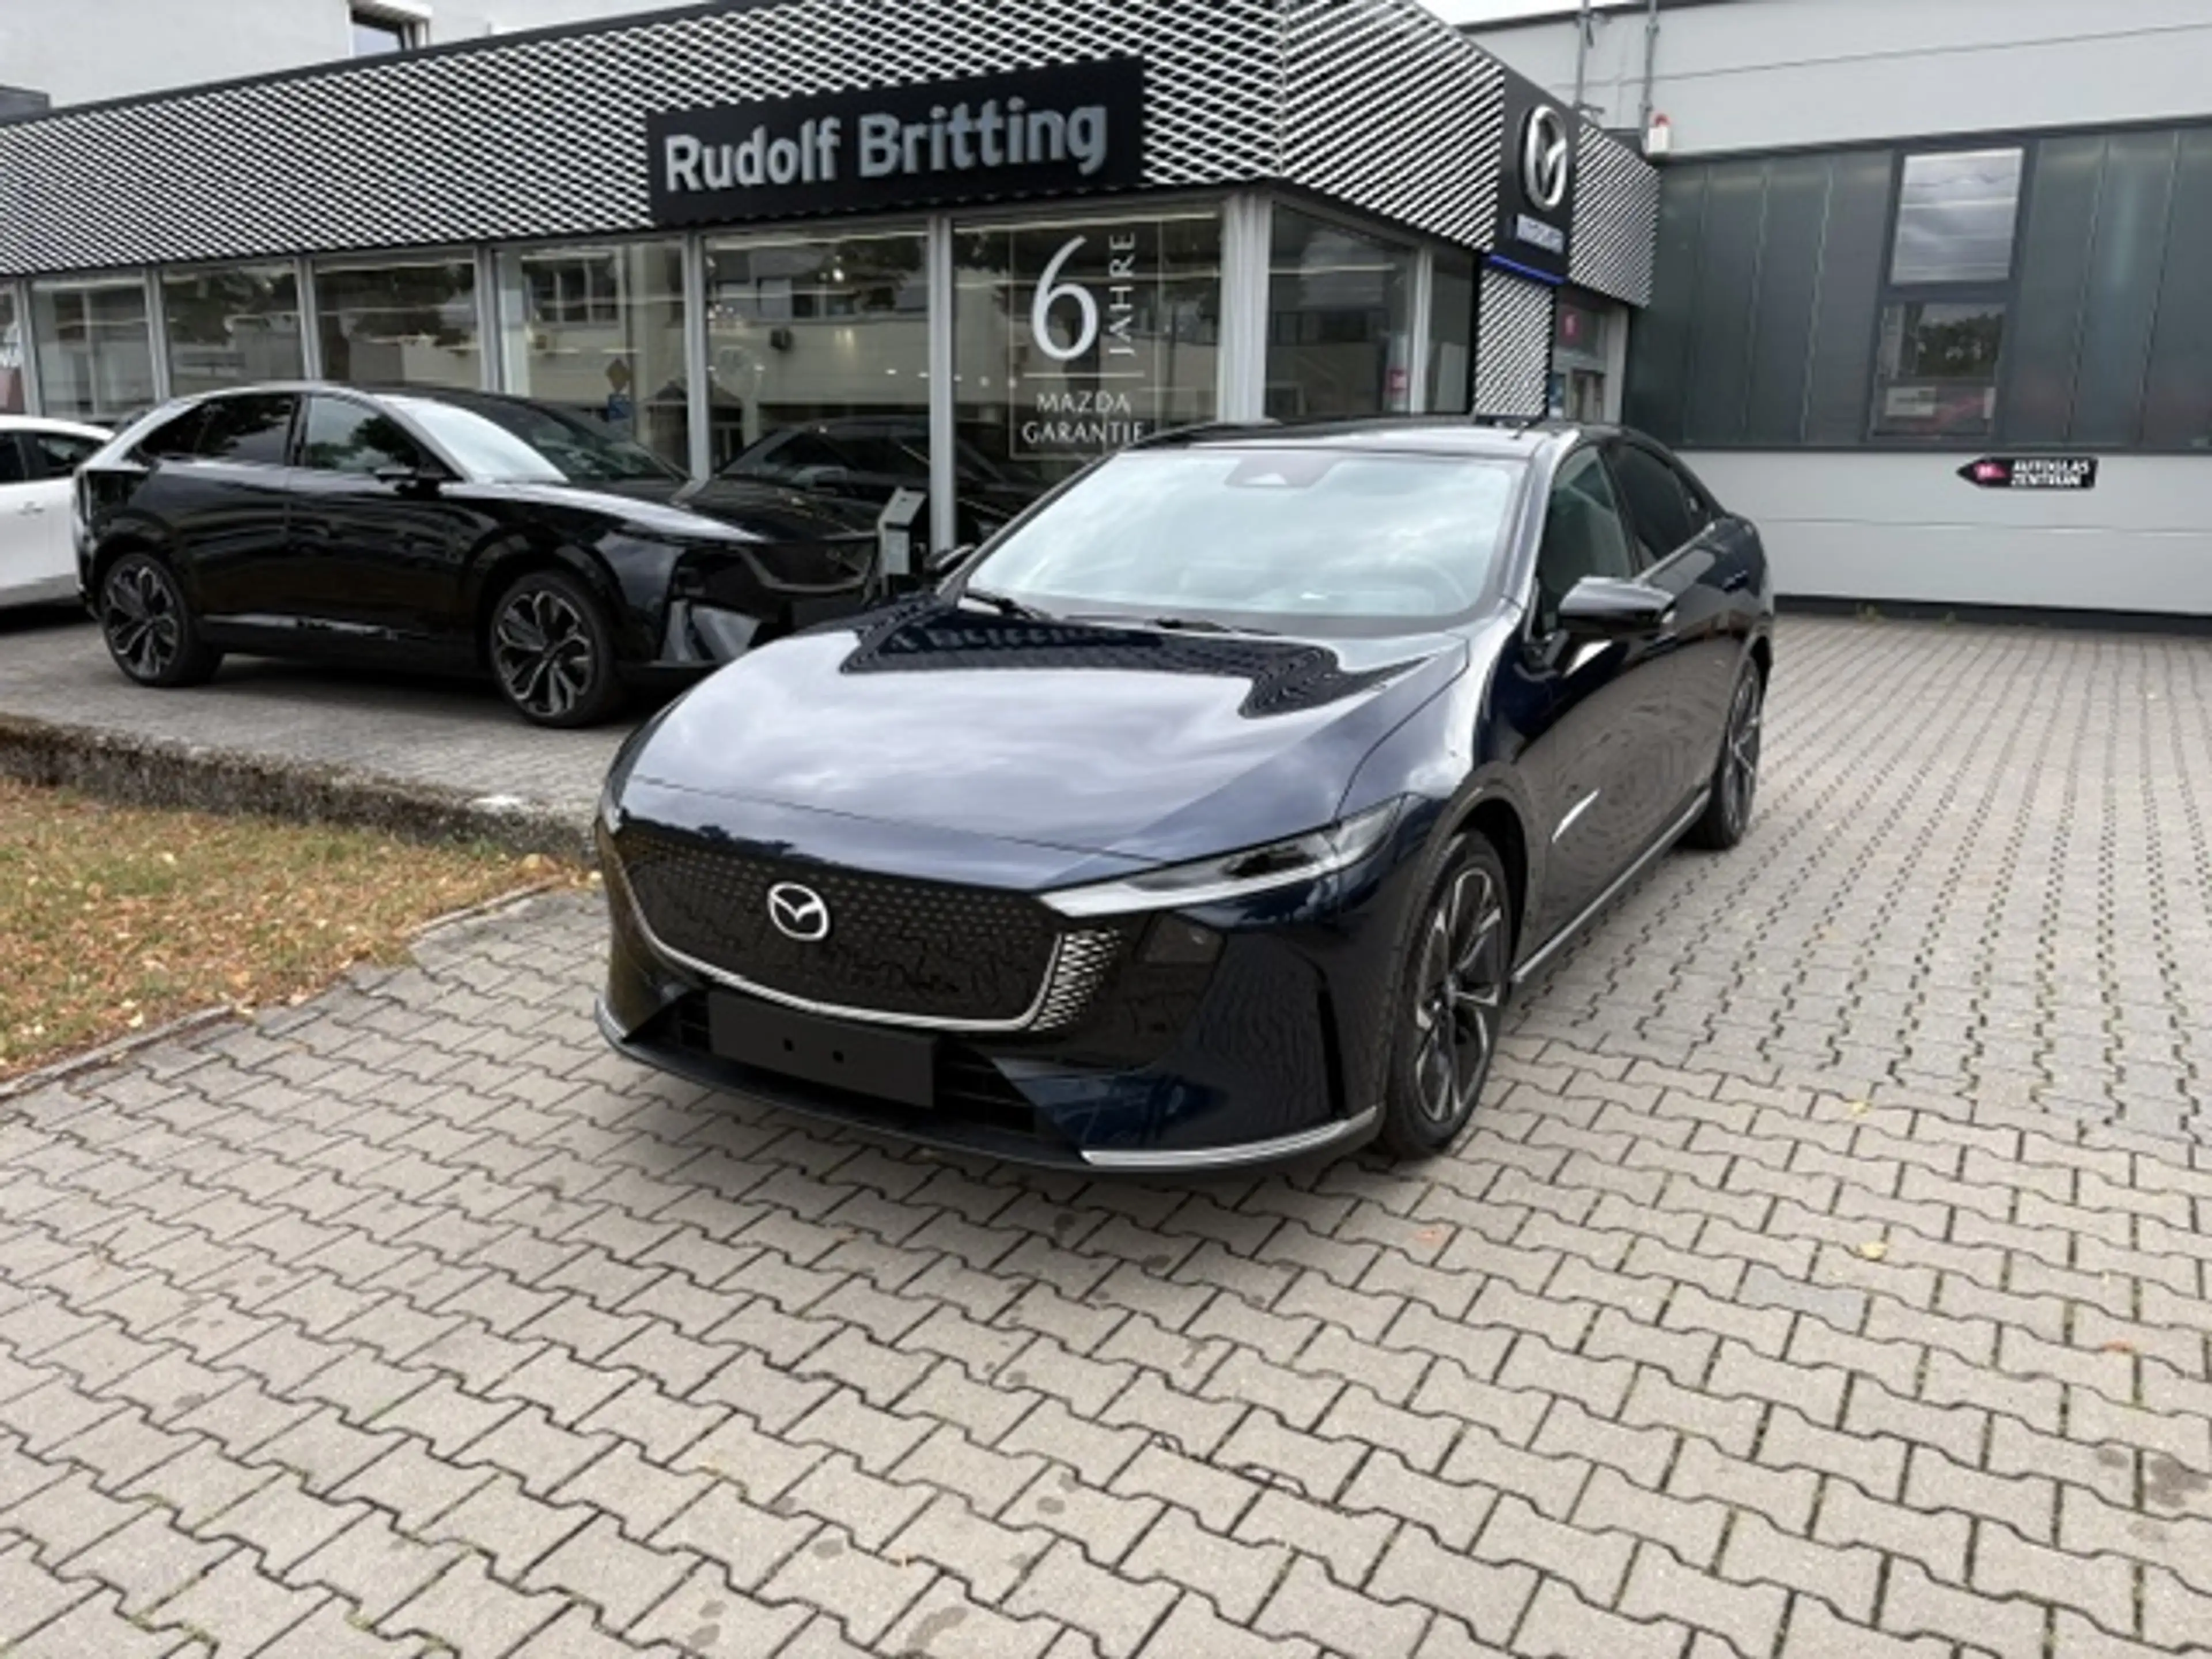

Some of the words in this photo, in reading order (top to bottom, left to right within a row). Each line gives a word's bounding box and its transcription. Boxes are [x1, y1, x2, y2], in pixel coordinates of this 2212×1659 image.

[664, 117, 842, 192] Rudolf
[859, 96, 1108, 176] Britting
[1031, 235, 1098, 361] 6
[1108, 232, 1135, 355] JAHRE
[1037, 390, 1132, 414] MAZDA
[1022, 421, 1144, 444] GARANTIE
